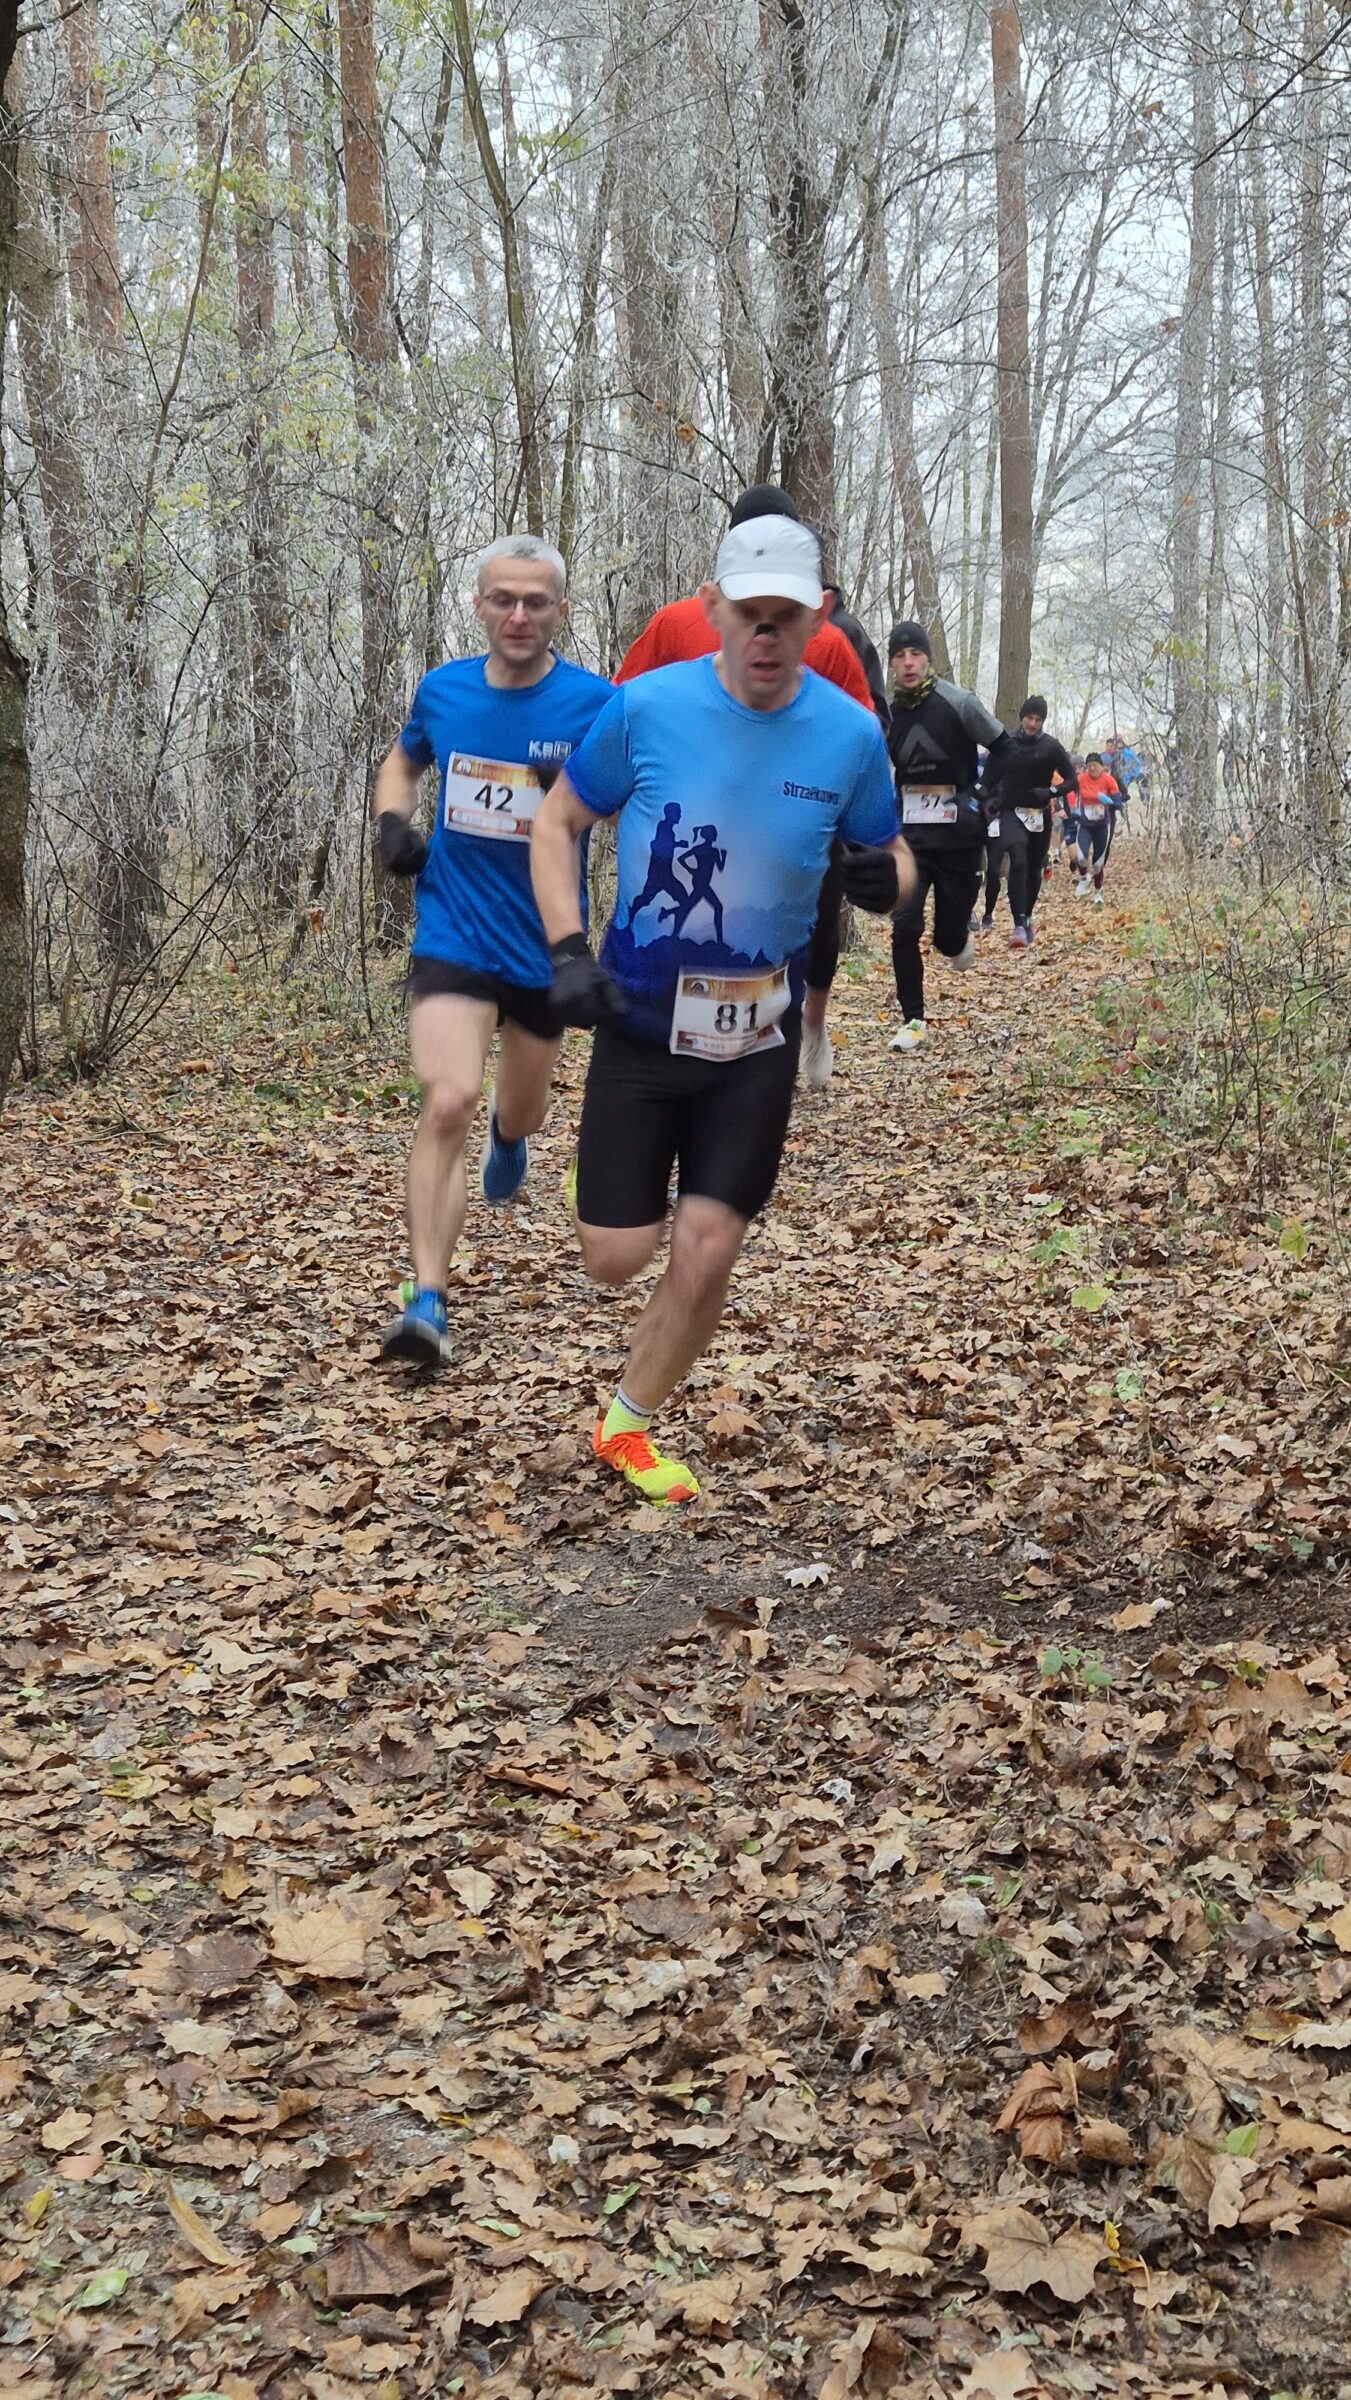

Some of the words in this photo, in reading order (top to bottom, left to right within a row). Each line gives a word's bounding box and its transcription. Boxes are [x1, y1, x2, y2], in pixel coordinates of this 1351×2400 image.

[474, 782, 514, 813] 42
[921, 794, 941, 809] 57
[714, 1003, 759, 1034] 81
